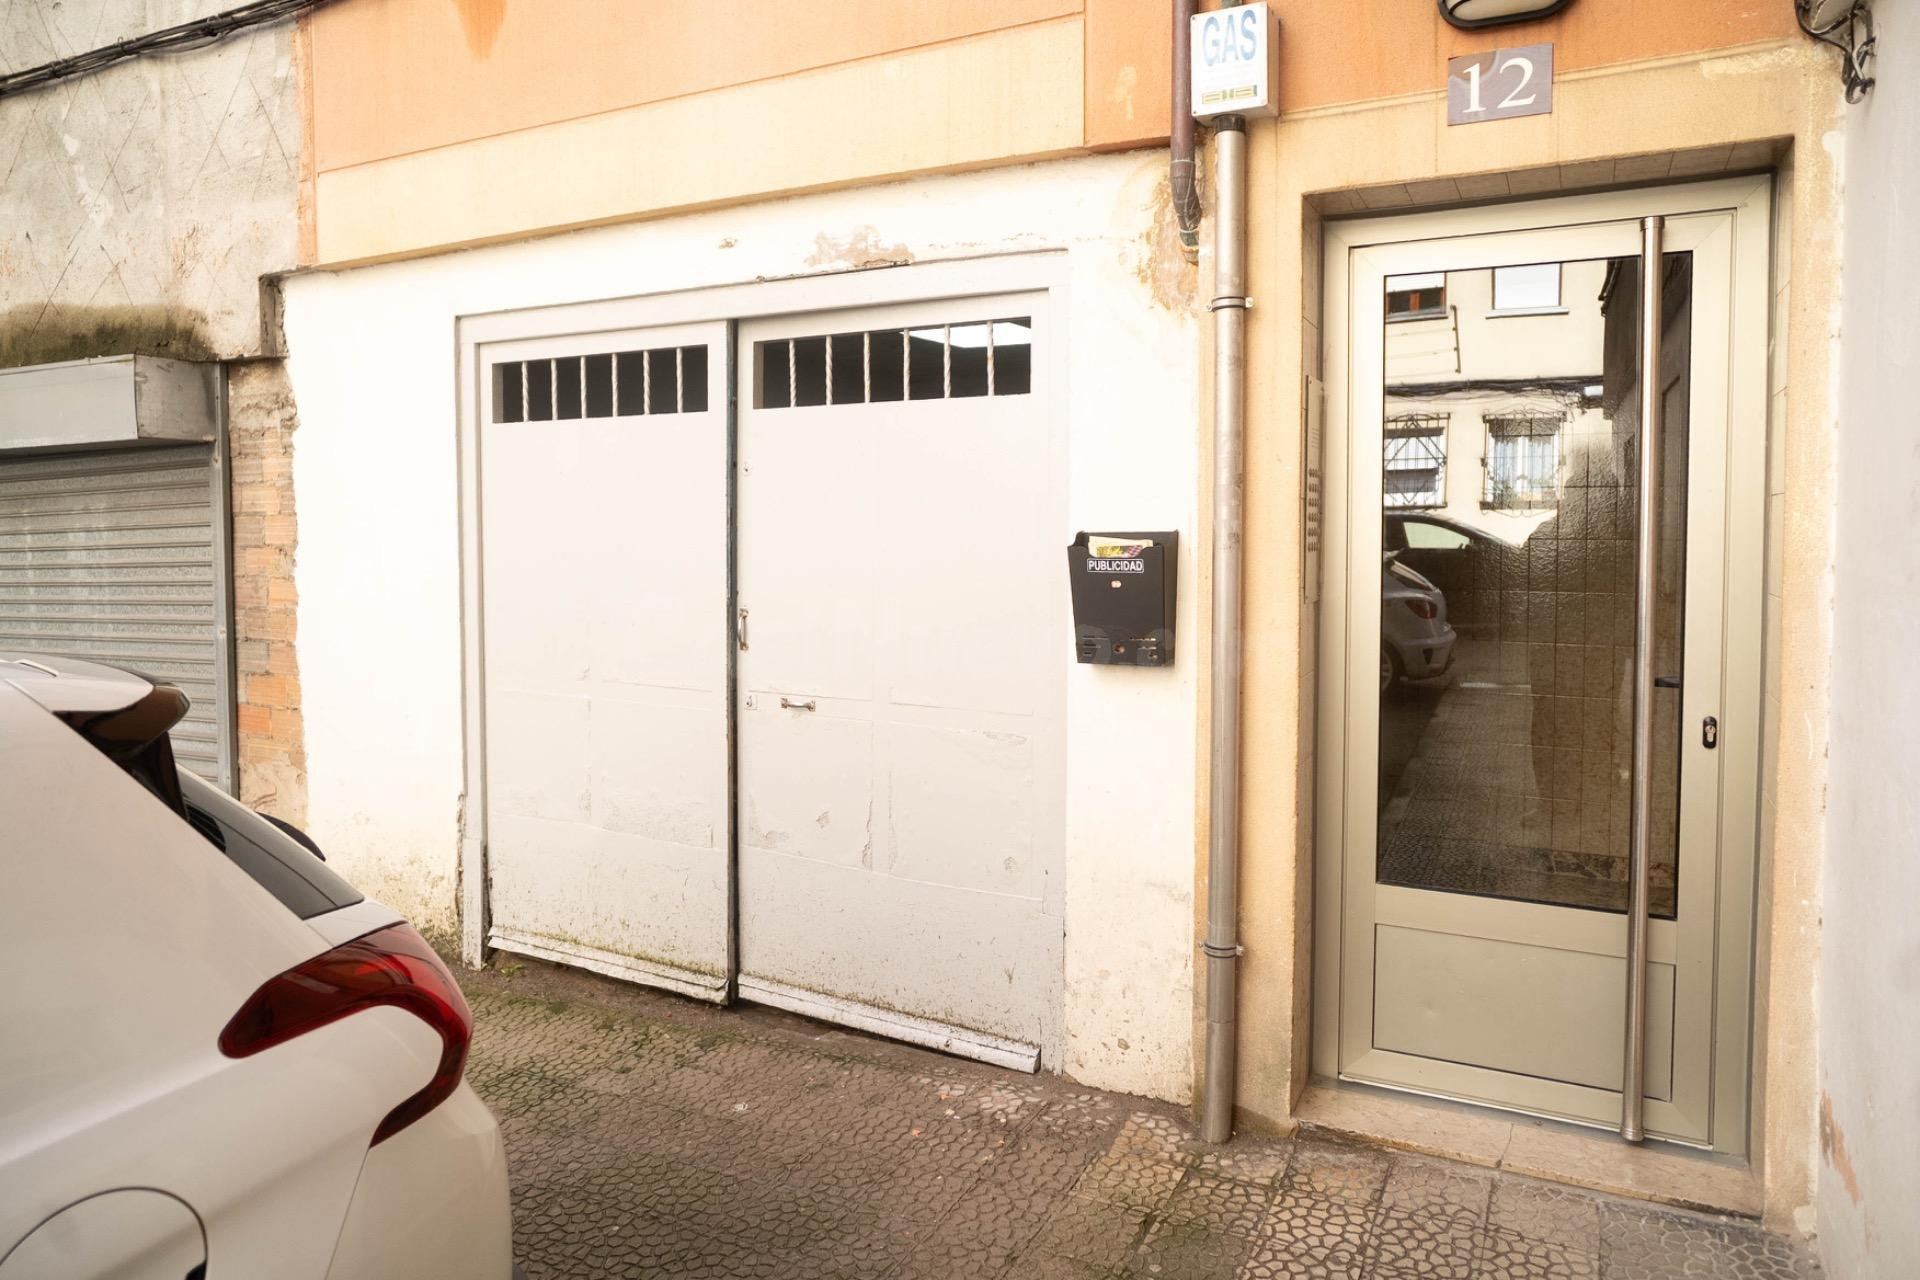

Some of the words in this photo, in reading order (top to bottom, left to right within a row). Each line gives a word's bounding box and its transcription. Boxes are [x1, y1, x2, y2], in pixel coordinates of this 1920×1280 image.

[1202, 9, 1257, 67] GAS
[1462, 57, 1537, 113] 12
[1088, 560, 1143, 571] PUBLICIDAD
